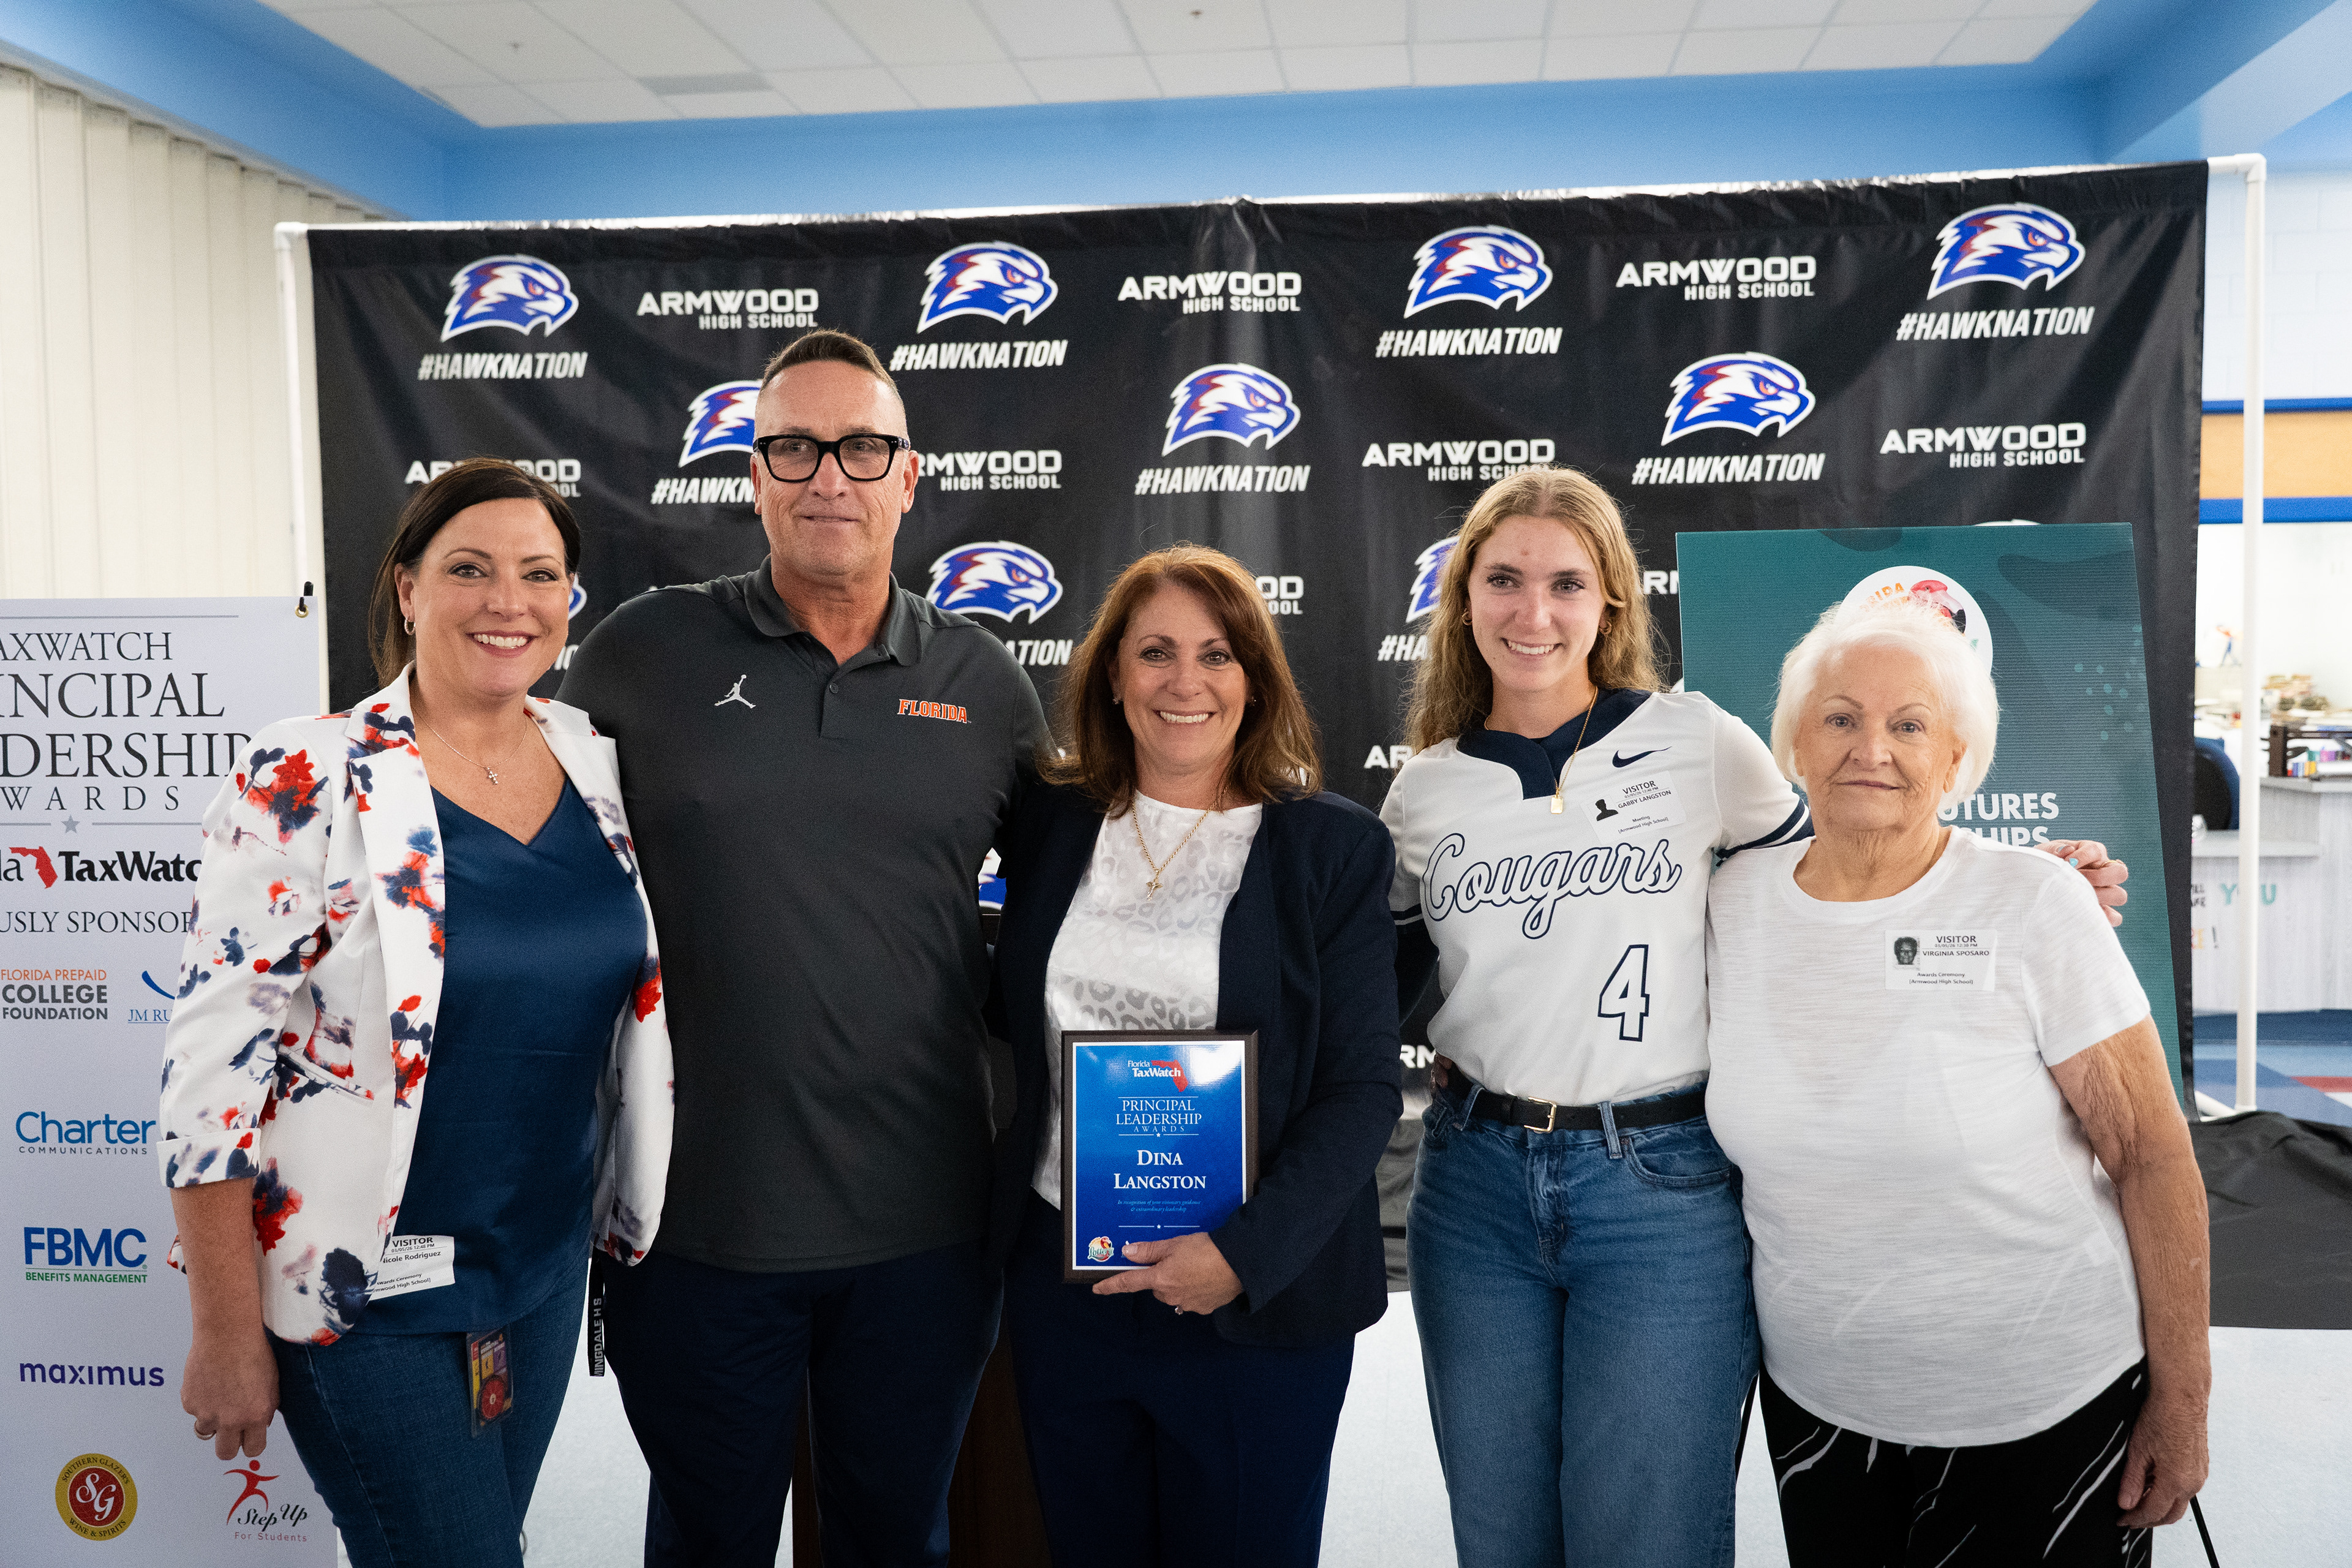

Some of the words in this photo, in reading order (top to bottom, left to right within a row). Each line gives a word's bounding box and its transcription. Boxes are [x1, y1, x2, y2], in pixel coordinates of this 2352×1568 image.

[1616, 255, 1817, 288] ARMWOOD
[1117, 271, 1302, 301] ARMWOOD
[1684, 284, 1732, 301] HIGH
[1737, 281, 1815, 299] SCHOOL
[637, 288, 820, 316] ARMWOOD
[1183, 296, 1224, 314] HIGH
[1230, 296, 1301, 312] SCHOOL
[699, 314, 741, 330] HIGH
[747, 311, 818, 328] SCHOOL
[1896, 306, 2095, 341] #HAWKNATION
[1376, 326, 1563, 358] #HAWKNATION
[889, 339, 1068, 371] #HAWKNATION
[418, 352, 588, 380] #HAWKNATION
[1879, 422, 2086, 454] ARMWOOD
[1362, 438, 1556, 467] ARMWOOD
[1949, 451, 1996, 468] HIGH
[2003, 448, 2086, 467] SCHOOL
[1428, 465, 1473, 481] HIGH
[1631, 453, 1826, 486] #HAWKNATION
[940, 475, 984, 491] HIGH
[989, 474, 1062, 490] SCHOOL
[1134, 465, 1311, 496] #HAWKNATION
[897, 699, 967, 724] FLORIDA
[1622, 780, 1656, 794] VISITOR
[0, 785, 179, 811] WARDS
[1618, 799, 1638, 809] GABBY
[1640, 790, 1672, 803] LANGSTON
[1422, 832, 1683, 940] Cougars
[2220, 883, 2277, 906] YU
[1, 969, 52, 981] FLORIDA
[55, 969, 107, 981] PREPAID
[2, 984, 108, 1004] COLLEGE
[1597, 944, 1650, 1042] 4
[2, 1007, 108, 1020] FOUNDATION
[128, 1009, 148, 1022] JM
[1132, 1068, 1181, 1077] TaxWatch
[1122, 1099, 1195, 1111] PRINCIPAL
[15, 1110, 156, 1145] Charter
[1116, 1113, 1202, 1125] LEADERSHIP
[19, 1146, 148, 1155] COMMUNICATIONS
[1137, 1149, 1183, 1166] DINA
[1114, 1173, 1207, 1189] LANGSTON
[23, 1226, 147, 1268] FBMC
[392, 1237, 434, 1248] VISITOR
[404, 1251, 441, 1260] Rodriguez
[26, 1272, 71, 1282] BENEFITS
[74, 1273, 148, 1284] MANAGEMENT
[19, 1362, 165, 1387] maximus
[62, 1457, 98, 1482] SOUTHERN
[69, 1517, 89, 1535] WINE
[99, 1519, 127, 1537] SPIRITS
[237, 1508, 277, 1532] Step
[280, 1503, 308, 1527] Up
[258, 1532, 307, 1542] Students
